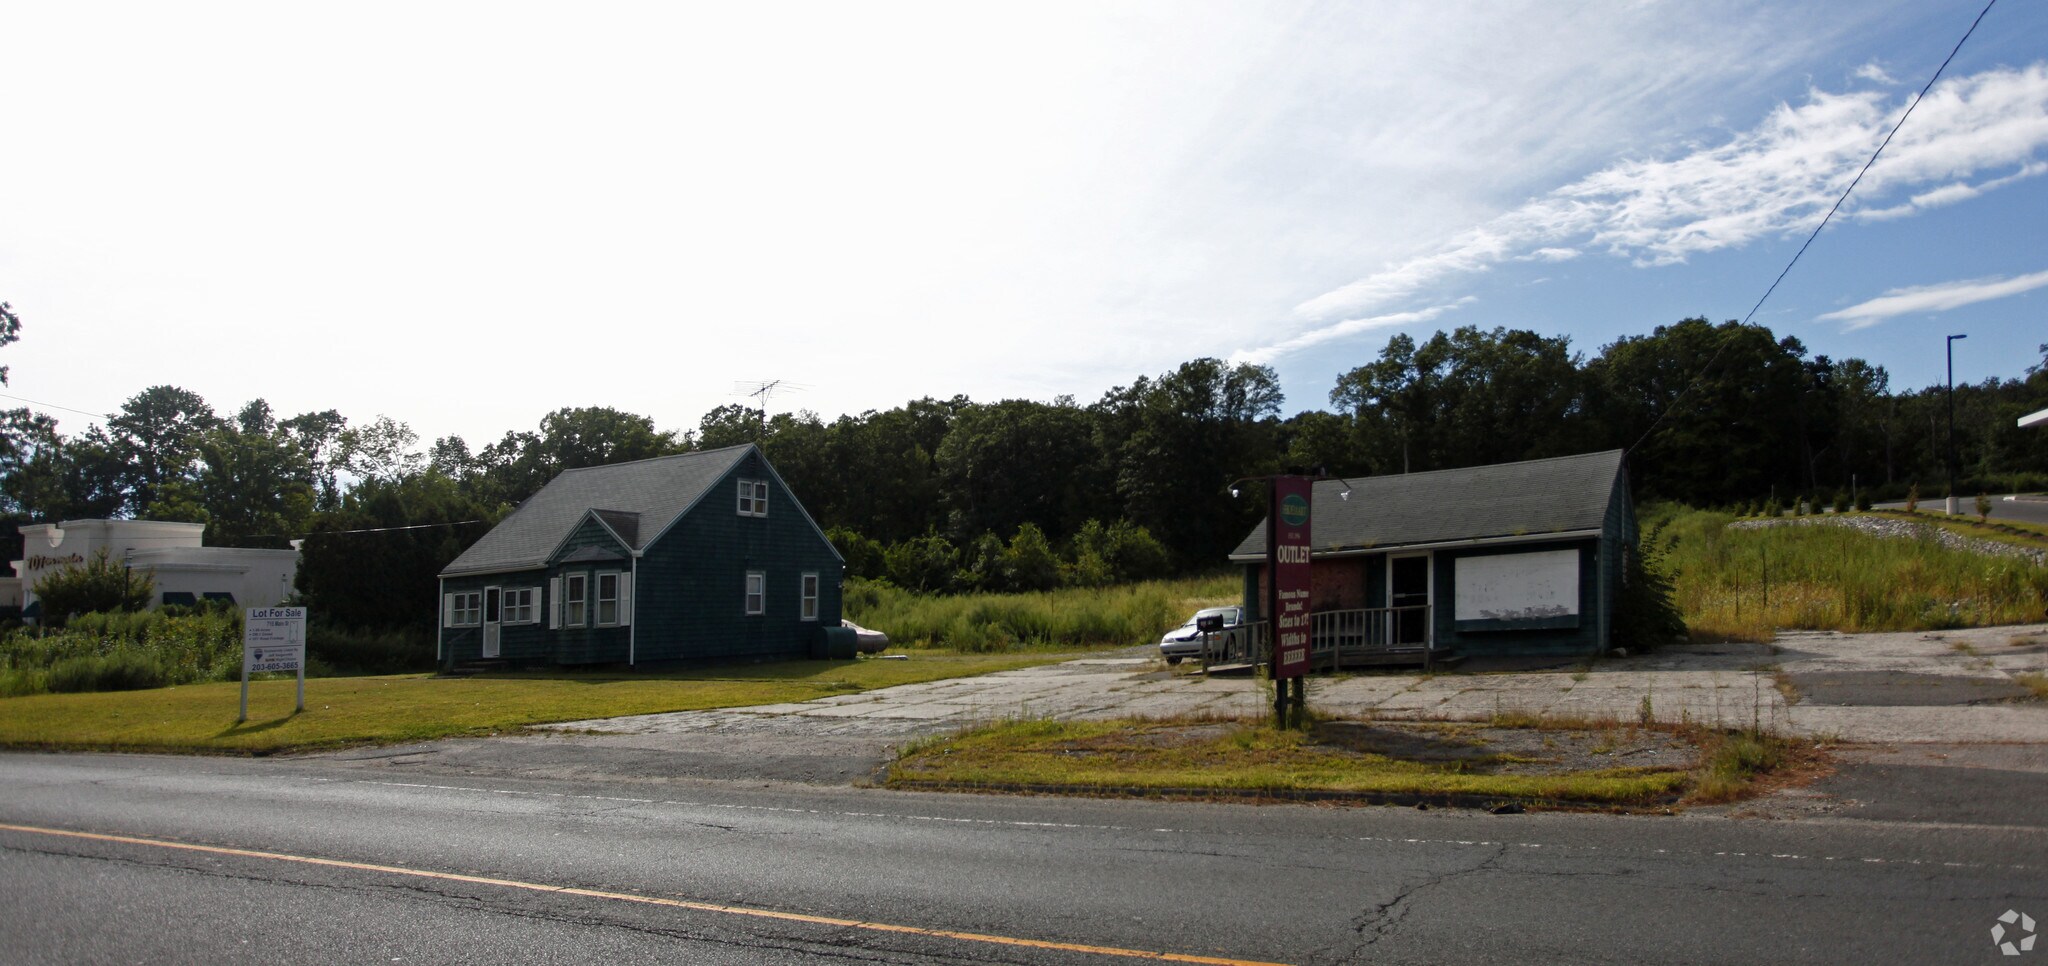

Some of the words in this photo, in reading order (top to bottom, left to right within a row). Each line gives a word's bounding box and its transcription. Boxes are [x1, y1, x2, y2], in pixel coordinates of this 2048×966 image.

[1277, 545, 1310, 564] OUTLET
[1278, 589, 1296, 600] Famous
[1296, 589, 1309, 598] Name
[252, 609, 267, 617] Lot
[269, 609, 284, 617] For
[285, 609, 301, 617] Sale
[1279, 612, 1293, 629] Sizes
[1293, 614, 1300, 627] to
[1280, 631, 1300, 647] Widths
[1300, 632, 1307, 643] to
